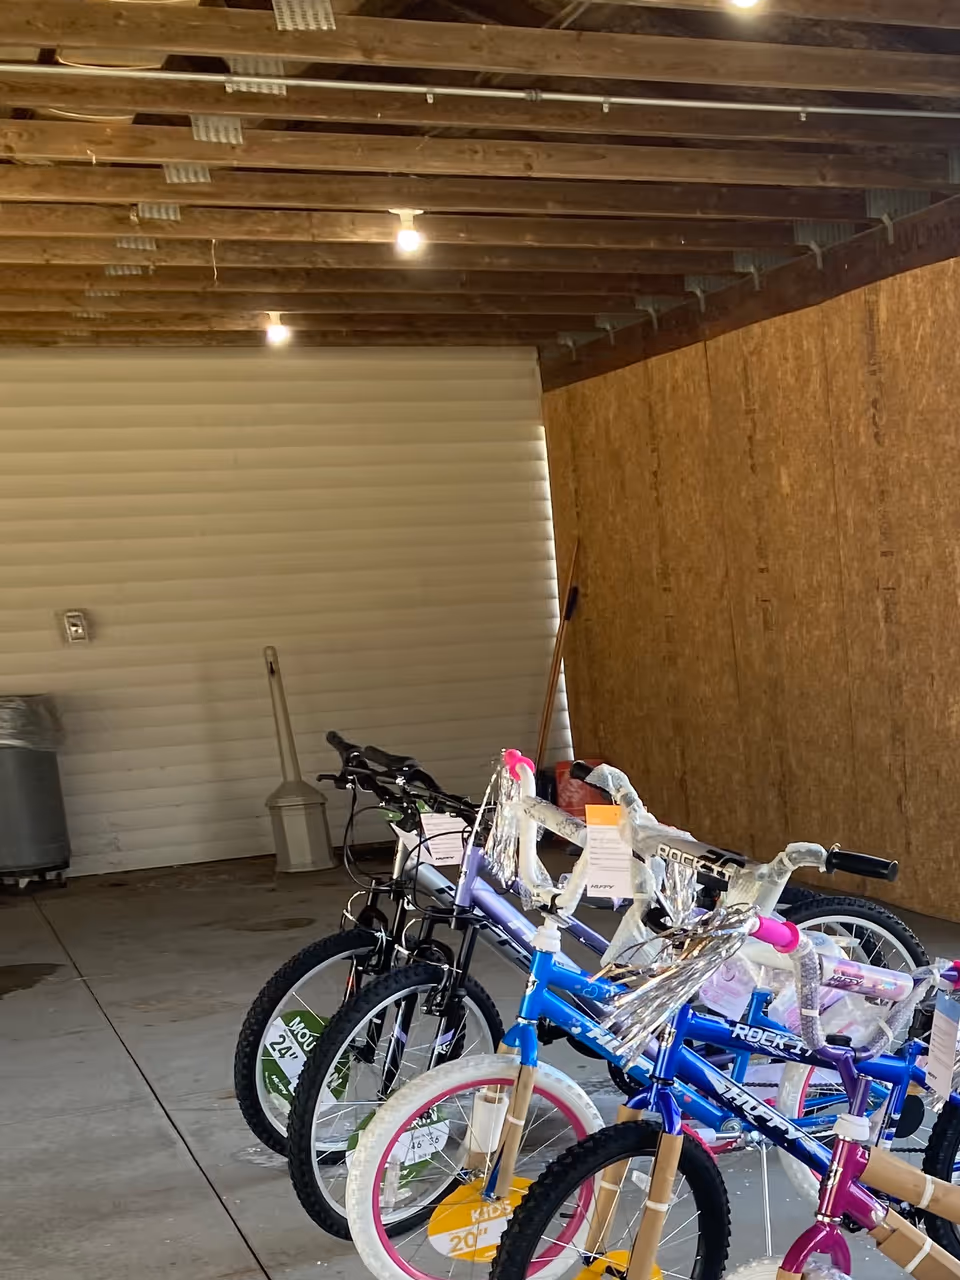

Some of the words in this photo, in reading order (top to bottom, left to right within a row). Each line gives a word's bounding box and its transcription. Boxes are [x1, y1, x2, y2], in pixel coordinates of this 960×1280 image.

[269, 1033, 299, 1060] 24"
[732, 1023, 789, 1050] ROCK
[720, 1083, 804, 1140] HUFFY
[471, 1199, 513, 1223] KIDS
[449, 1227, 488, 1251] 20"
